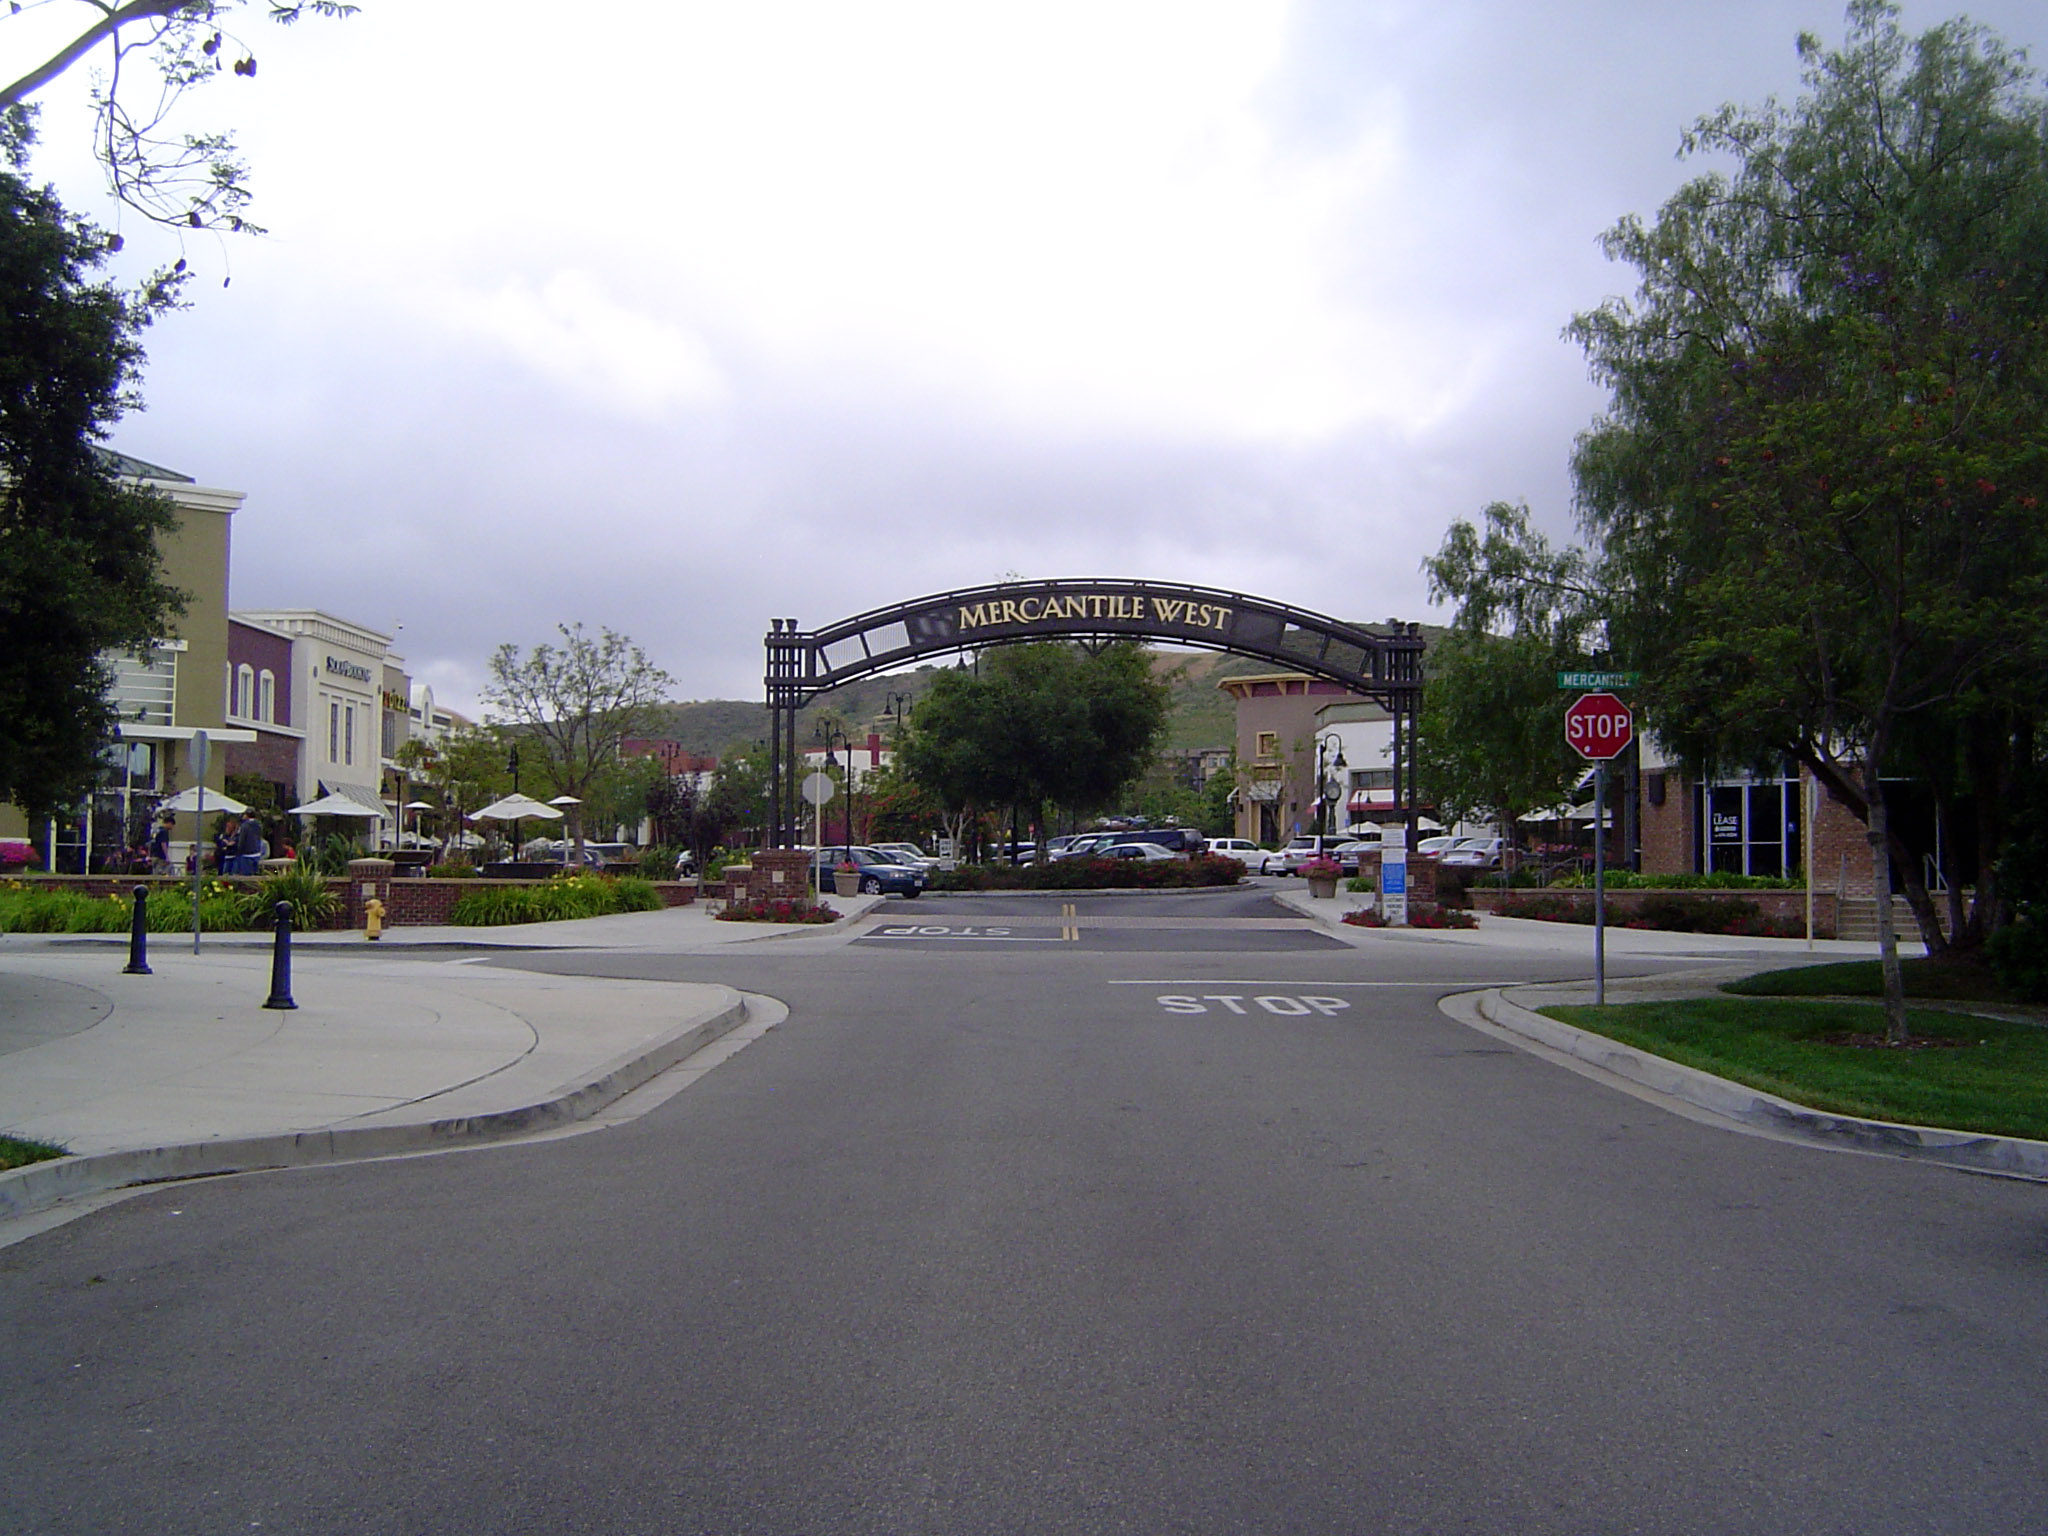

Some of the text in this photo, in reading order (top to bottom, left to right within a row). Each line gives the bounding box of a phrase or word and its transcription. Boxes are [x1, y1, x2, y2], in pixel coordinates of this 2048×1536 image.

[958, 595, 1233, 630] MERCANTILE WEST
[1563, 673, 1630, 687] MERCANTIL
[1570, 714, 1628, 738] STOP
[883, 926, 1013, 937] STOP
[1156, 995, 1351, 1017] STOP
